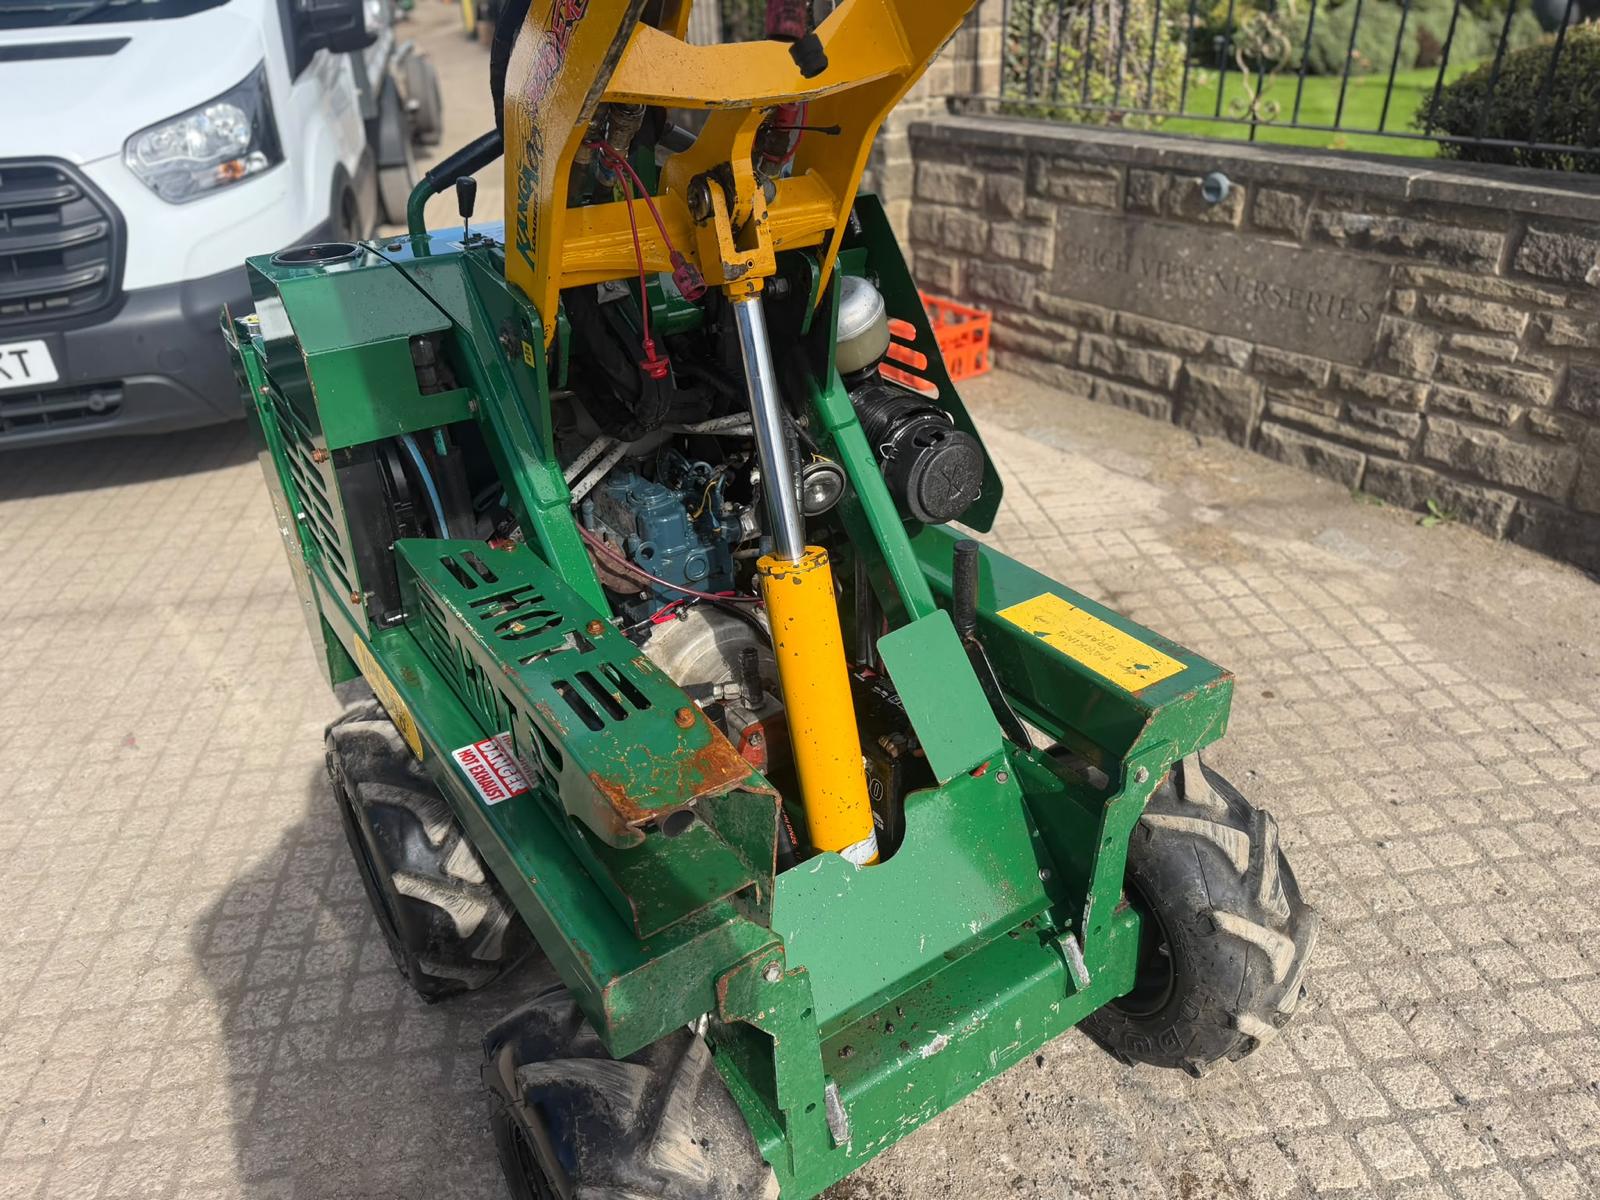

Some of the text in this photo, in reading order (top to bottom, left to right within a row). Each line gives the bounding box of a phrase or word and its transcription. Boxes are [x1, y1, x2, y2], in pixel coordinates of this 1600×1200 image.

[530, 191, 540, 255] LOADERS
[1062, 242, 1374, 325] CRICH VIEW NURSERIES
[467, 583, 597, 666] HOT
[1056, 630, 1112, 663] PARKING
[457, 748, 506, 801] HOT EXHAUST
[477, 738, 527, 793] DANGER
